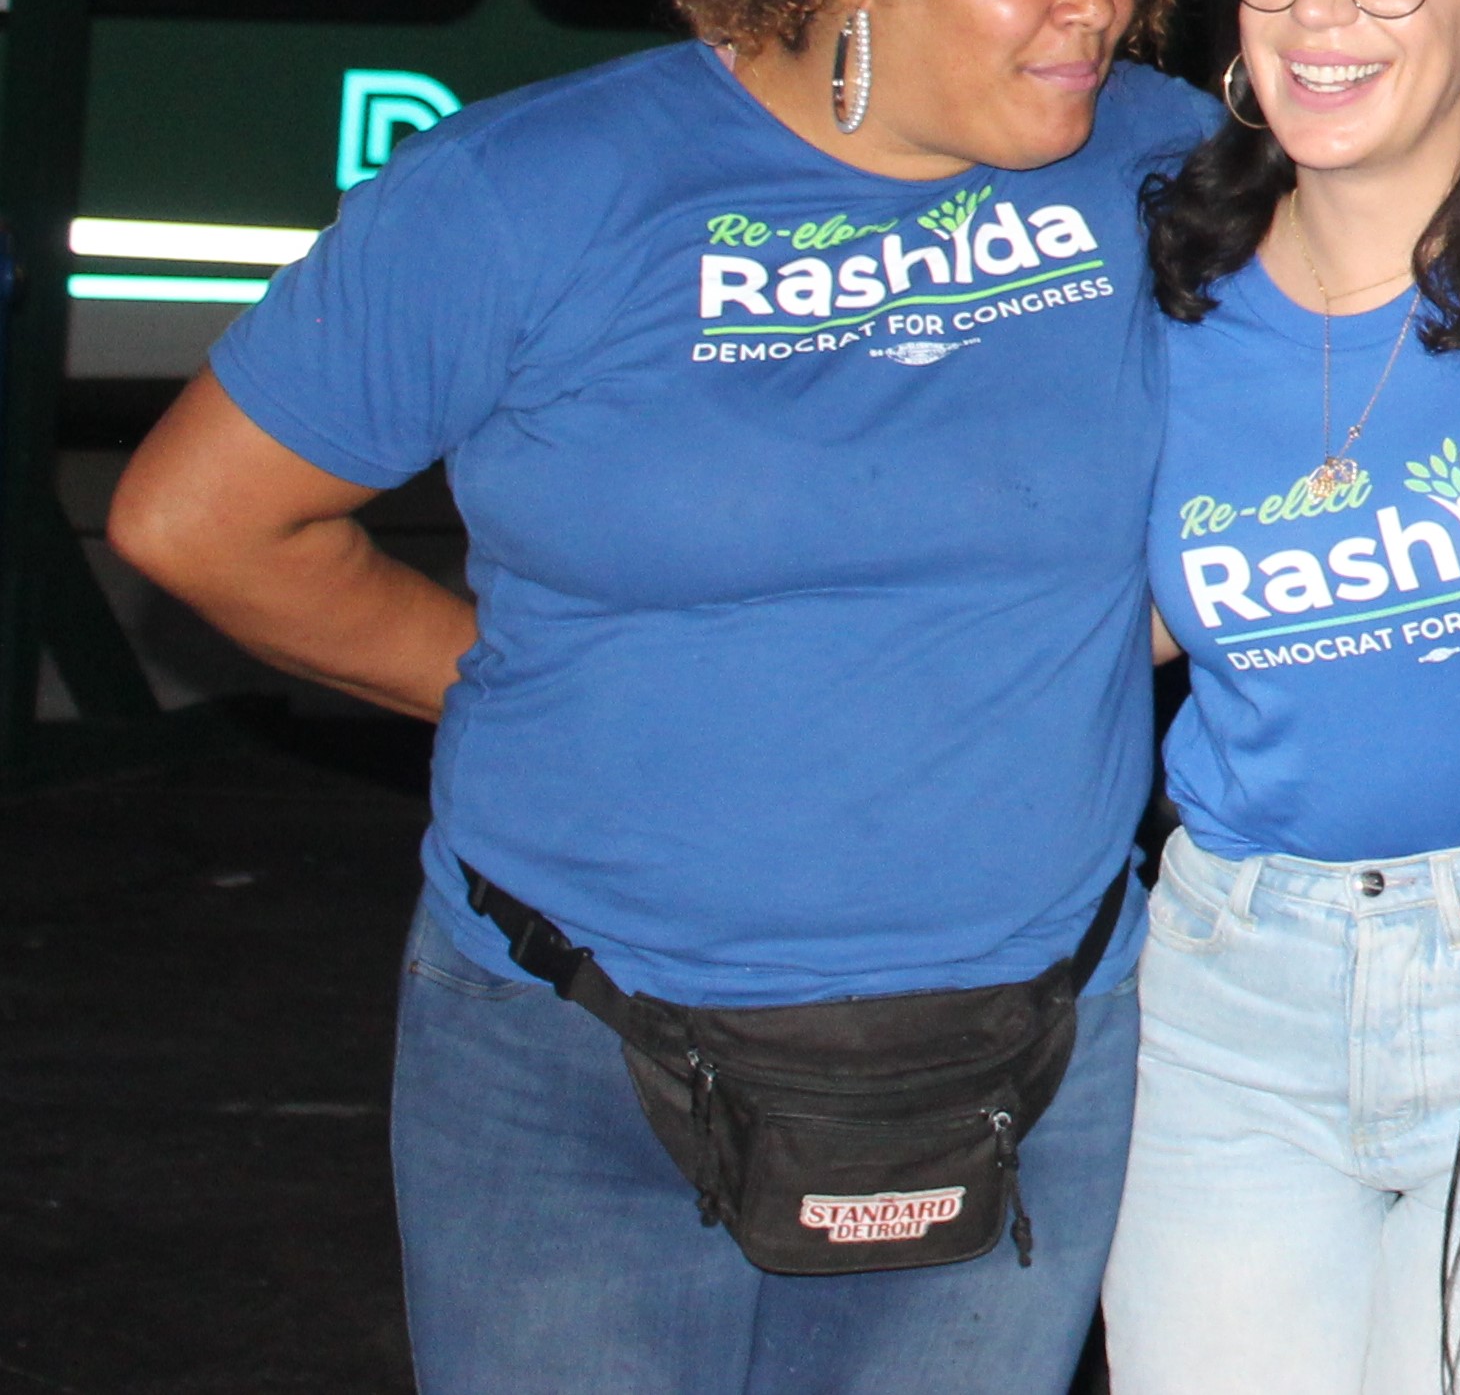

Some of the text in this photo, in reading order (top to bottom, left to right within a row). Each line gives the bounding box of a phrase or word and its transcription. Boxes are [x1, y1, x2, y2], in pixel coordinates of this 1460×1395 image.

[706, 213, 898, 250] Re-ele
[699, 202, 1099, 318] Rashida
[692, 321, 877, 363] DEMOCRAT
[888, 314, 945, 335] FOR
[953, 276, 1114, 330] CONGRESS
[1226, 628, 1393, 672] DEMOCRAT
[806, 1197, 956, 1224] STANDARD
[836, 1219, 927, 1240] DETROIT
